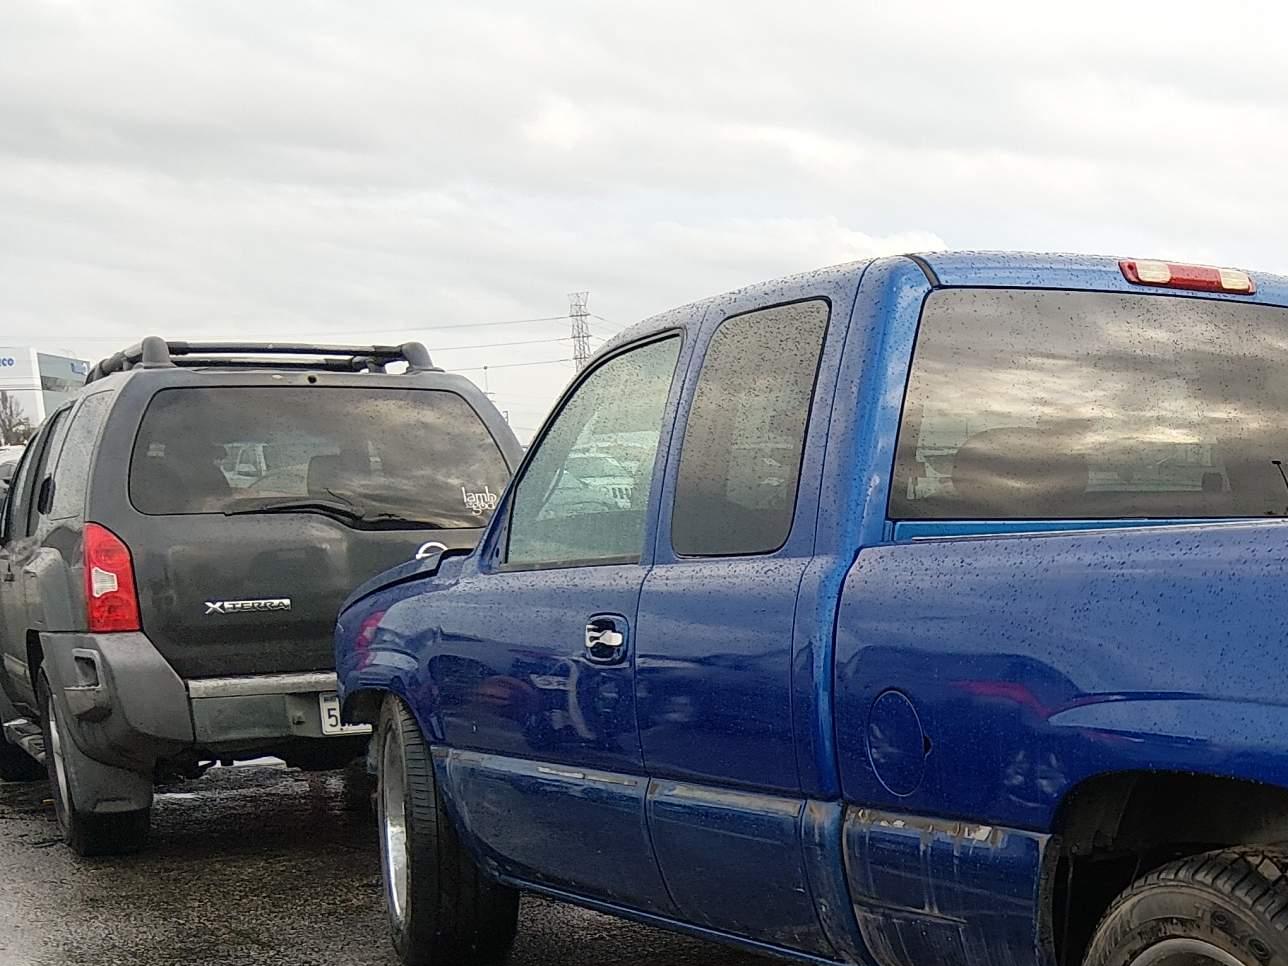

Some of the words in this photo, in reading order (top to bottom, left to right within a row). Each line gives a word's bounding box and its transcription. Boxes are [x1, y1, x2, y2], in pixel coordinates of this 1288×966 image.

[0, 358, 14, 367] co
[461, 486, 497, 503] lamb
[204, 599, 290, 614] XTERRA
